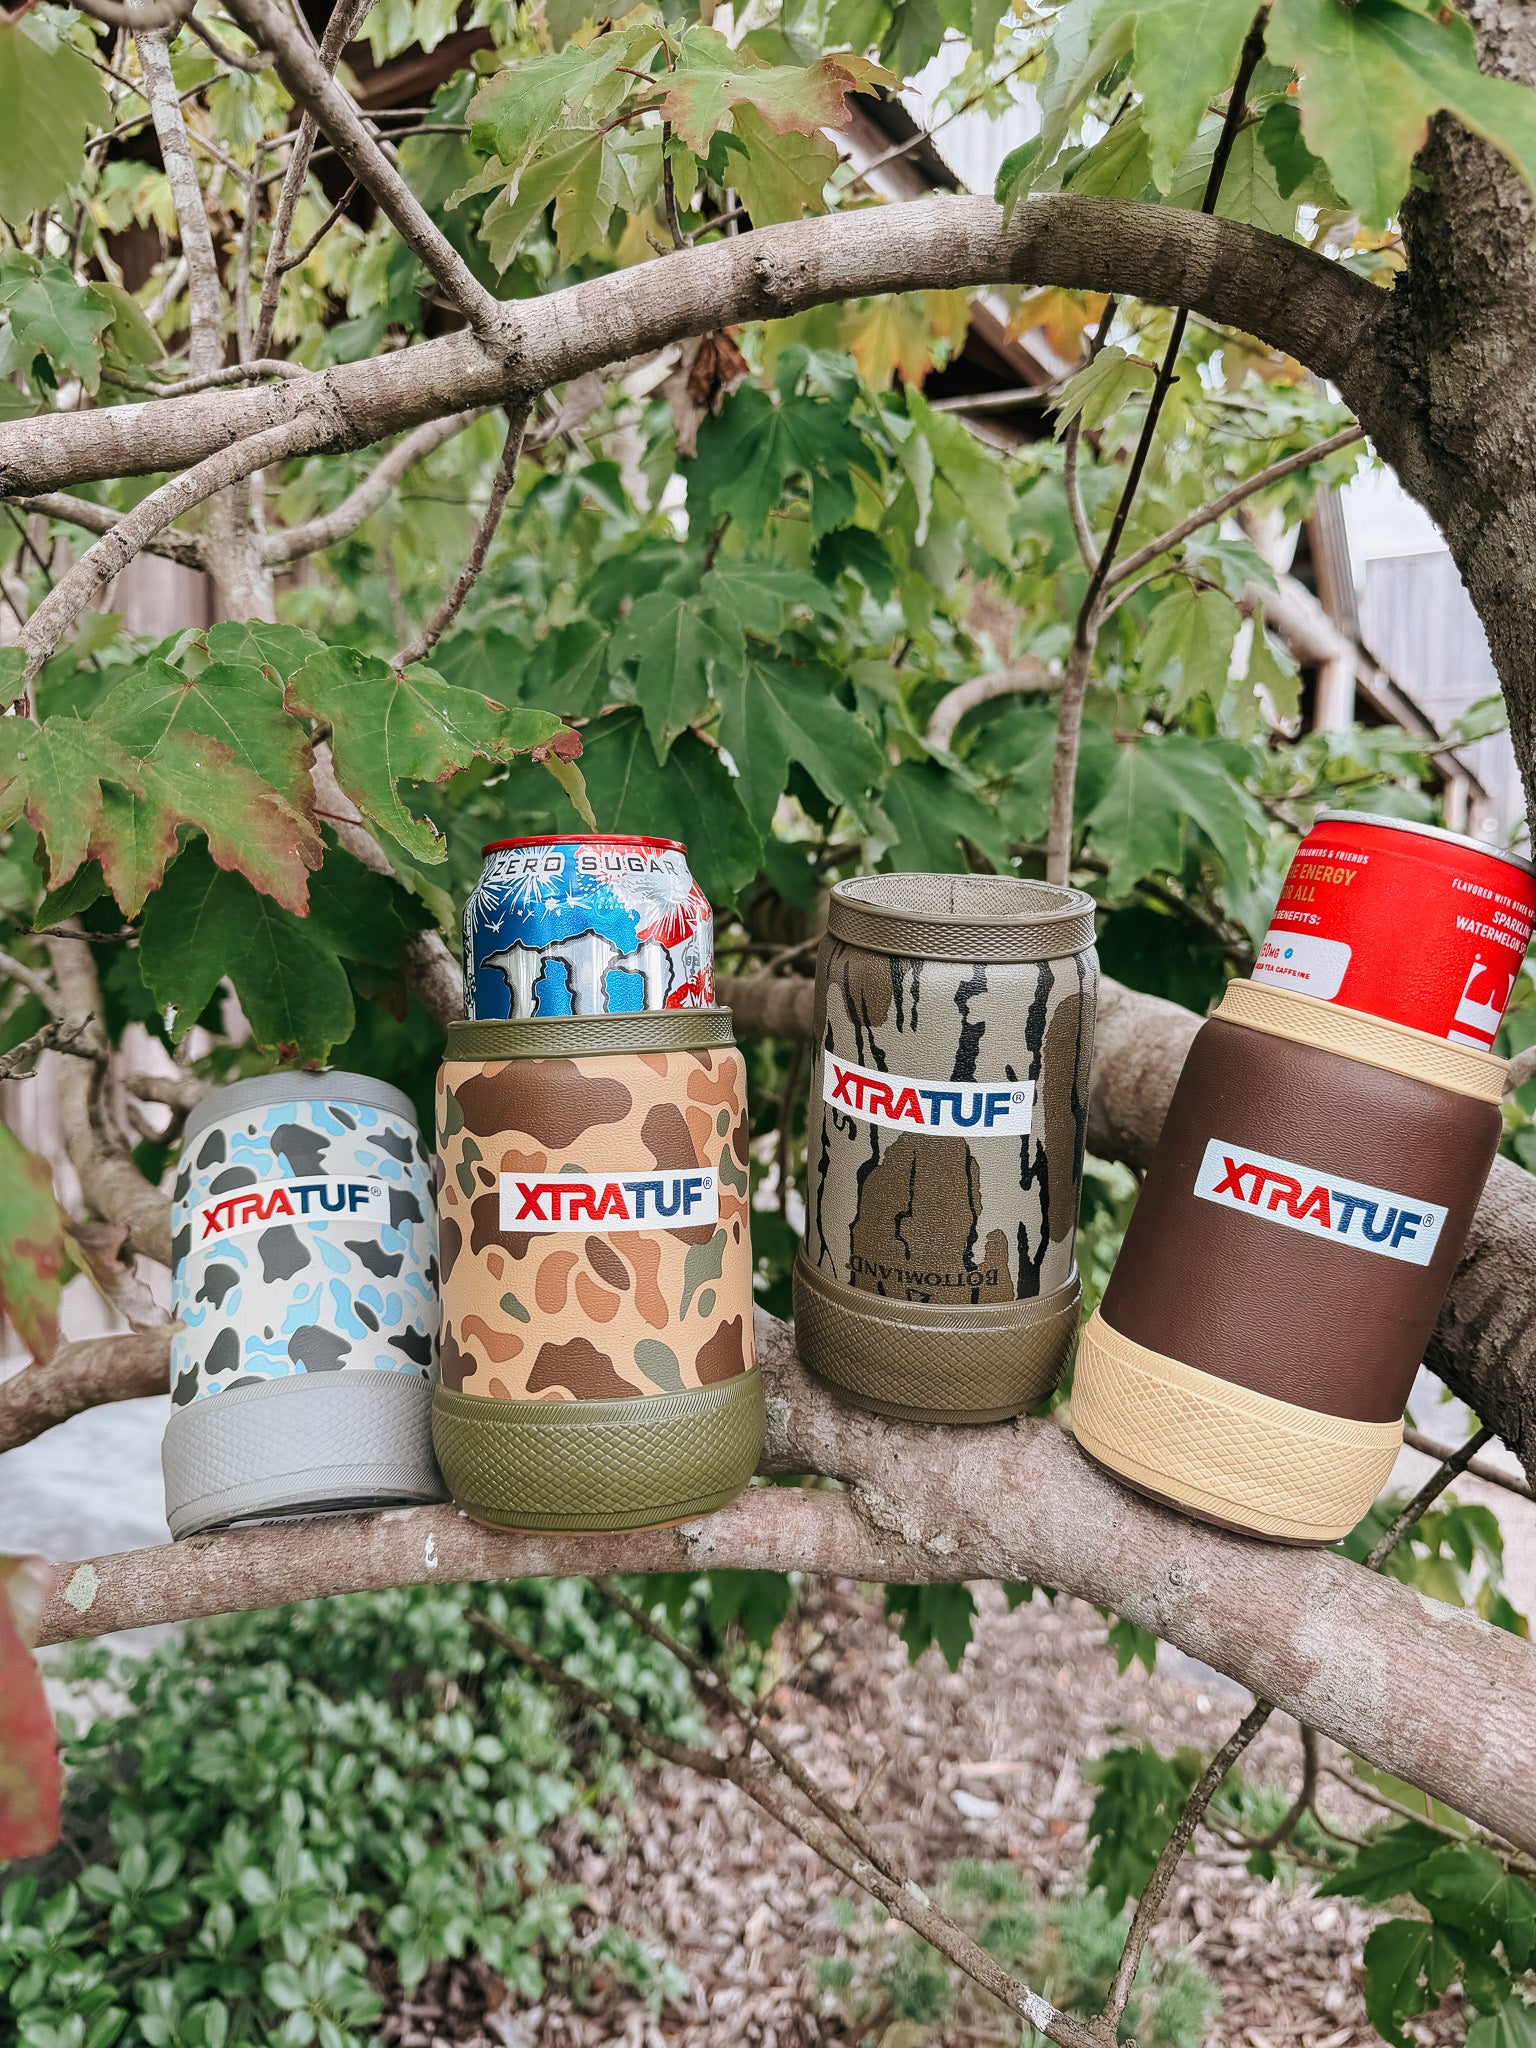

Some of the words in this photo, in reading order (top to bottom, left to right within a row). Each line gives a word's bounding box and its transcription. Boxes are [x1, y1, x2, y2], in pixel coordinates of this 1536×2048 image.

[493, 856, 562, 877] ZERO
[581, 856, 677, 876] SUGAR
[1327, 849, 1335, 859] &
[1335, 850, 1370, 865] FRIENDS
[1299, 863, 1358, 886] ENERGY
[1293, 885, 1316, 903] ALL
[1451, 878, 1493, 900] FLAVORED
[1494, 893, 1512, 907] WITH
[1455, 914, 1521, 951] WATERMELON
[1275, 966, 1311, 980] CAFFEINE
[849, 1254, 998, 1287] BOTTOMLAND
